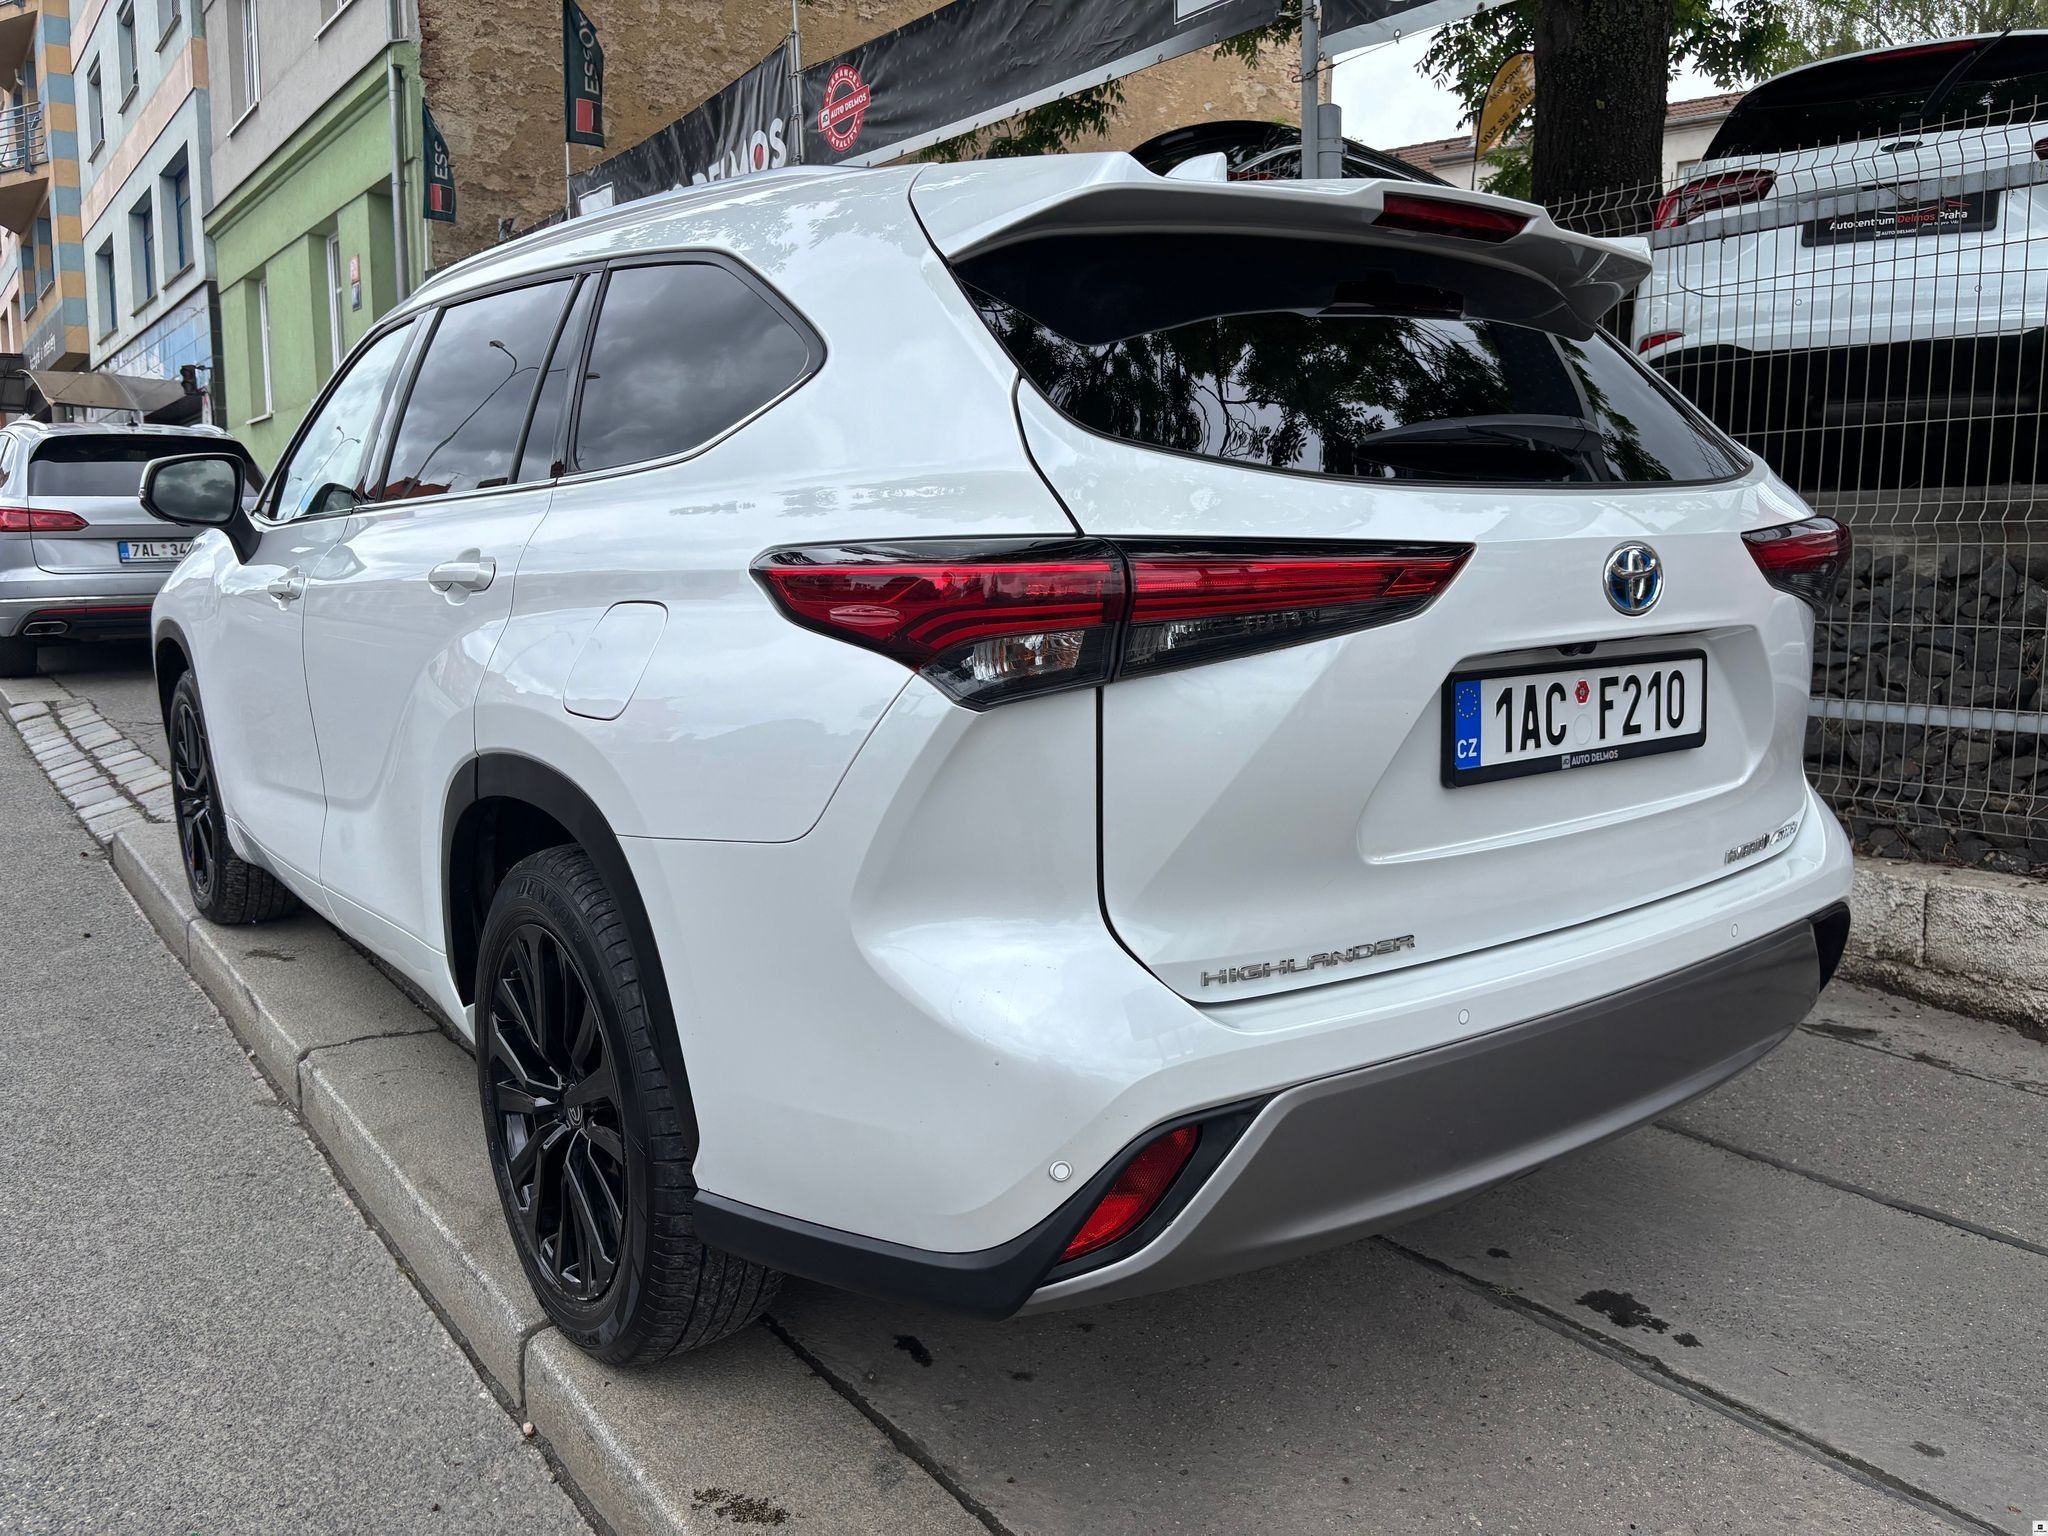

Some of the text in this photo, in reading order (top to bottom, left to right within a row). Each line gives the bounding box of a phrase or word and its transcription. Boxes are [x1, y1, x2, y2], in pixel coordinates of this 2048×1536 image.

[827, 69, 857, 93] GARANCE
[830, 104, 845, 120] AUTO
[845, 93, 867, 111] DELMOS
[831, 126, 858, 147] KVALITY
[692, 118, 786, 184] MOS
[1829, 209, 1968, 230] Autocentrum Delmos Praha
[131, 543, 191, 557] 7AL 34
[1495, 669, 1685, 753] 1AC F210
[1457, 738, 1477, 759] CZ
[1571, 753, 1590, 766] AUTO
[1591, 750, 1619, 762] DELMOS
[1200, 934, 1415, 987] HIGHLANDER
